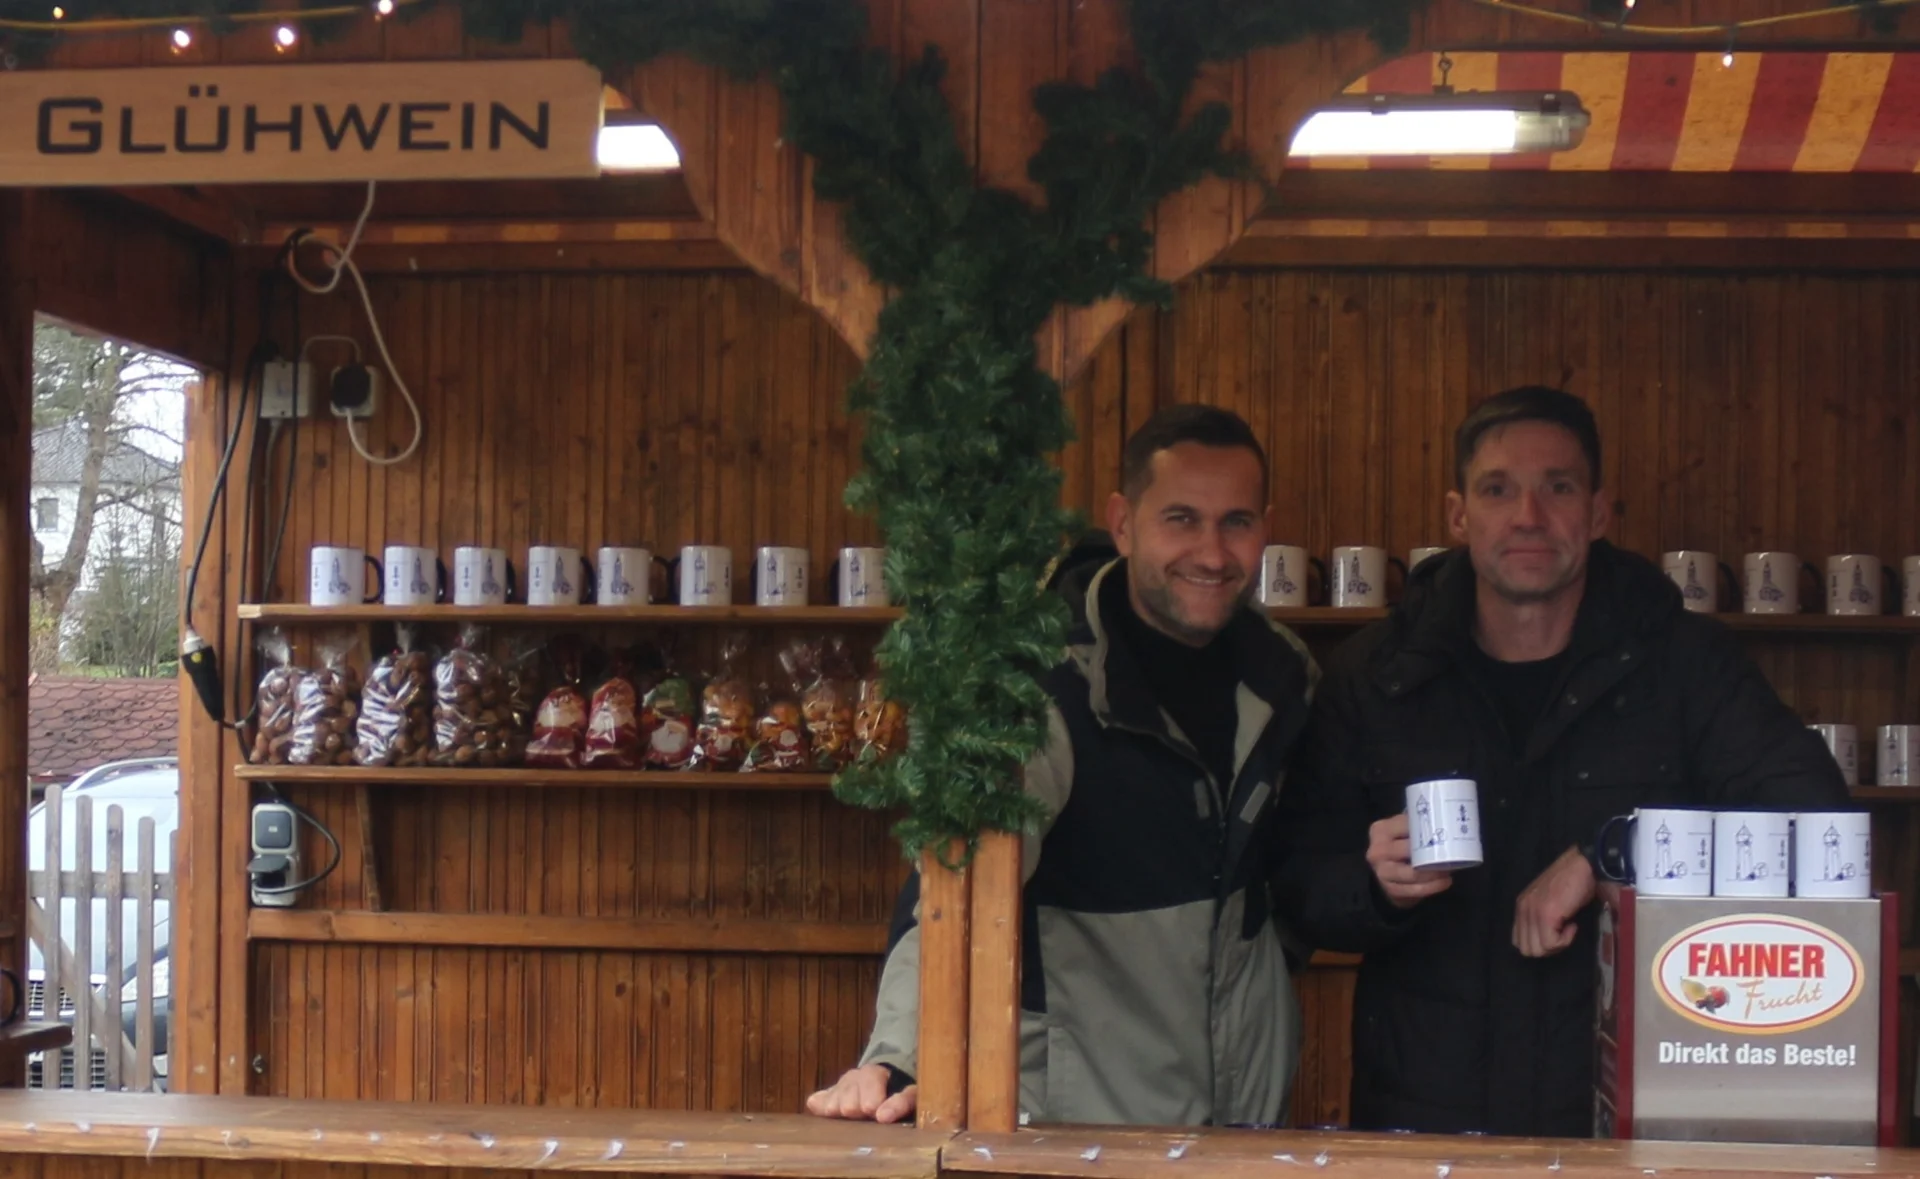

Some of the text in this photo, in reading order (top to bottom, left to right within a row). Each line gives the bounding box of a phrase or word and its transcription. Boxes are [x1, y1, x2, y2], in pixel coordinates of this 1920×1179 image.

[36, 85, 550, 155] GLÜHWEIN
[1689, 944, 1825, 978] FAHNER
[1737, 979, 1824, 1018] Frucht
[1659, 1042, 1856, 1066] Direkt das Beste!
